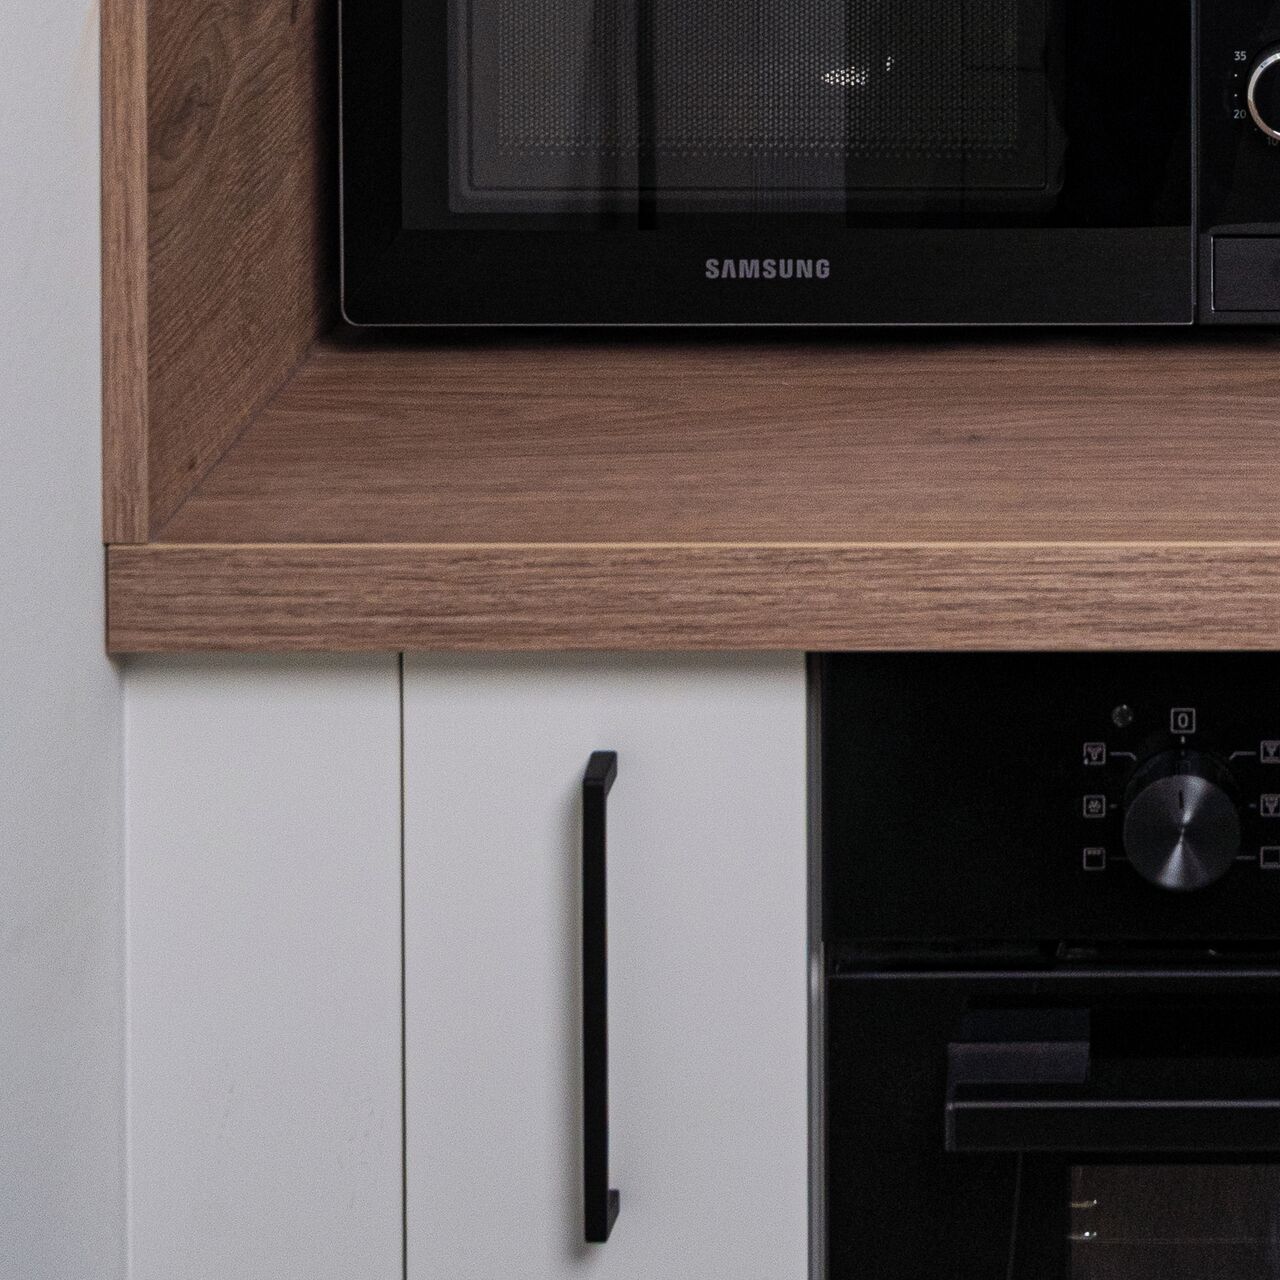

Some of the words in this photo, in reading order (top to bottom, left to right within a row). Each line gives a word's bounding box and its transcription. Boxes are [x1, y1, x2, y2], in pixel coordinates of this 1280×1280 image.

[1234, 51, 1247, 61] 35
[1233, 109, 1247, 119] 20
[705, 258, 830, 279] SAMSUNG
